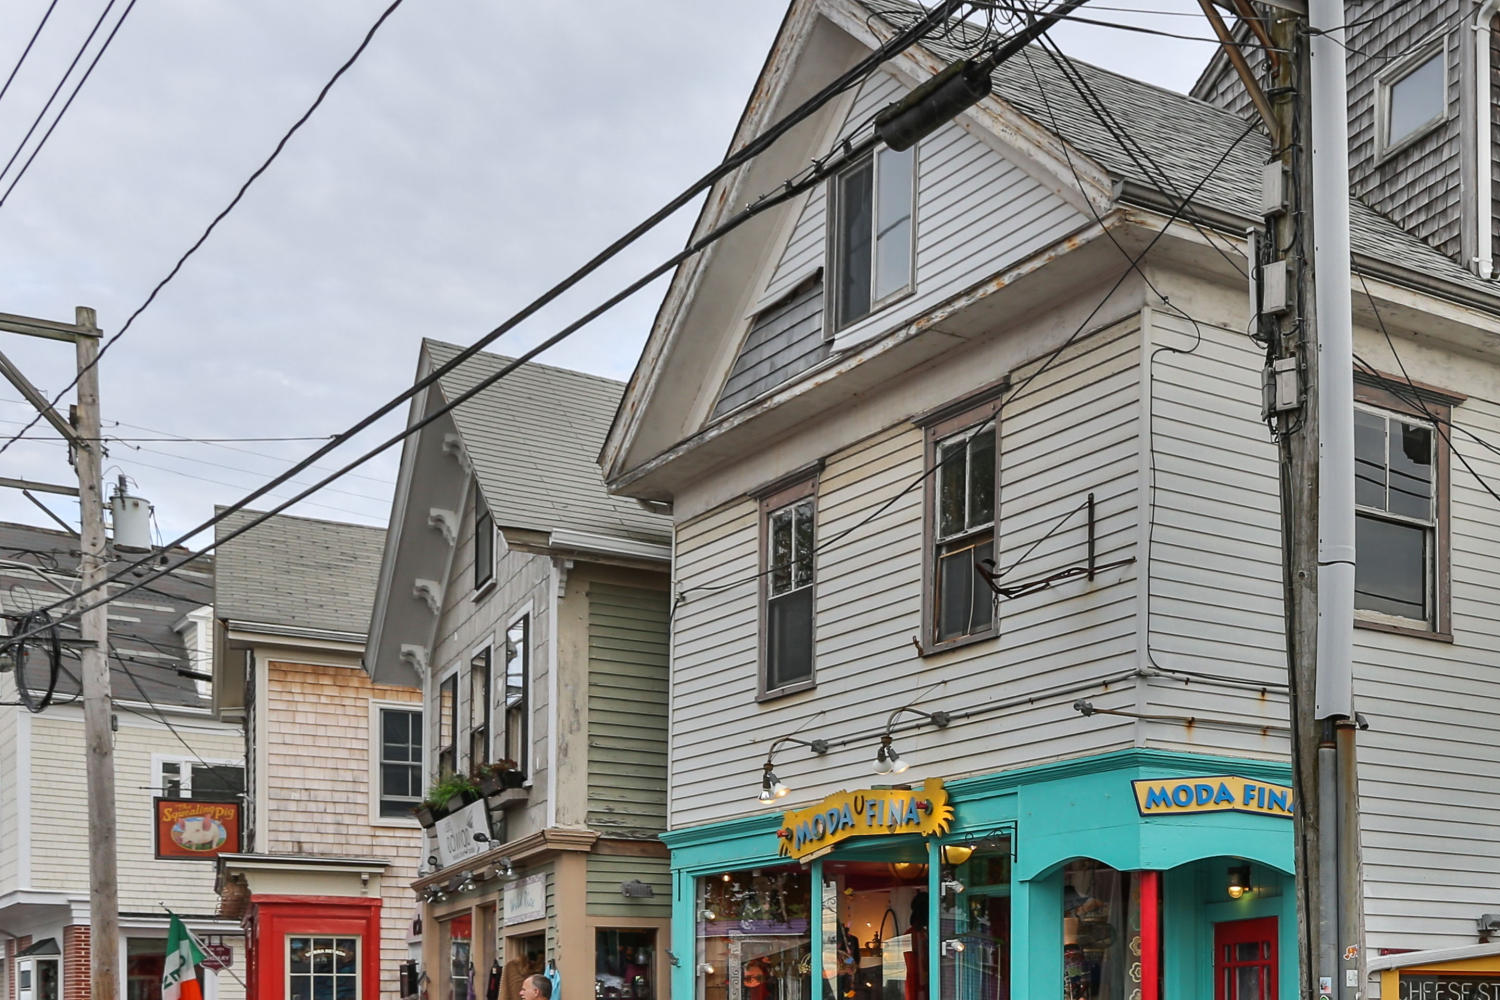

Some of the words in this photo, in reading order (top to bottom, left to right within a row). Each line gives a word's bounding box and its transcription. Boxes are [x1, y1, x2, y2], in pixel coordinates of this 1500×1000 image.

[163, 804, 215, 821] Squealing
[215, 807, 235, 820] Pig
[1144, 782, 1235, 809] MODA
[1243, 783, 1294, 813] FIN
[795, 802, 855, 850] MODA
[865, 796, 921, 827] FINA
